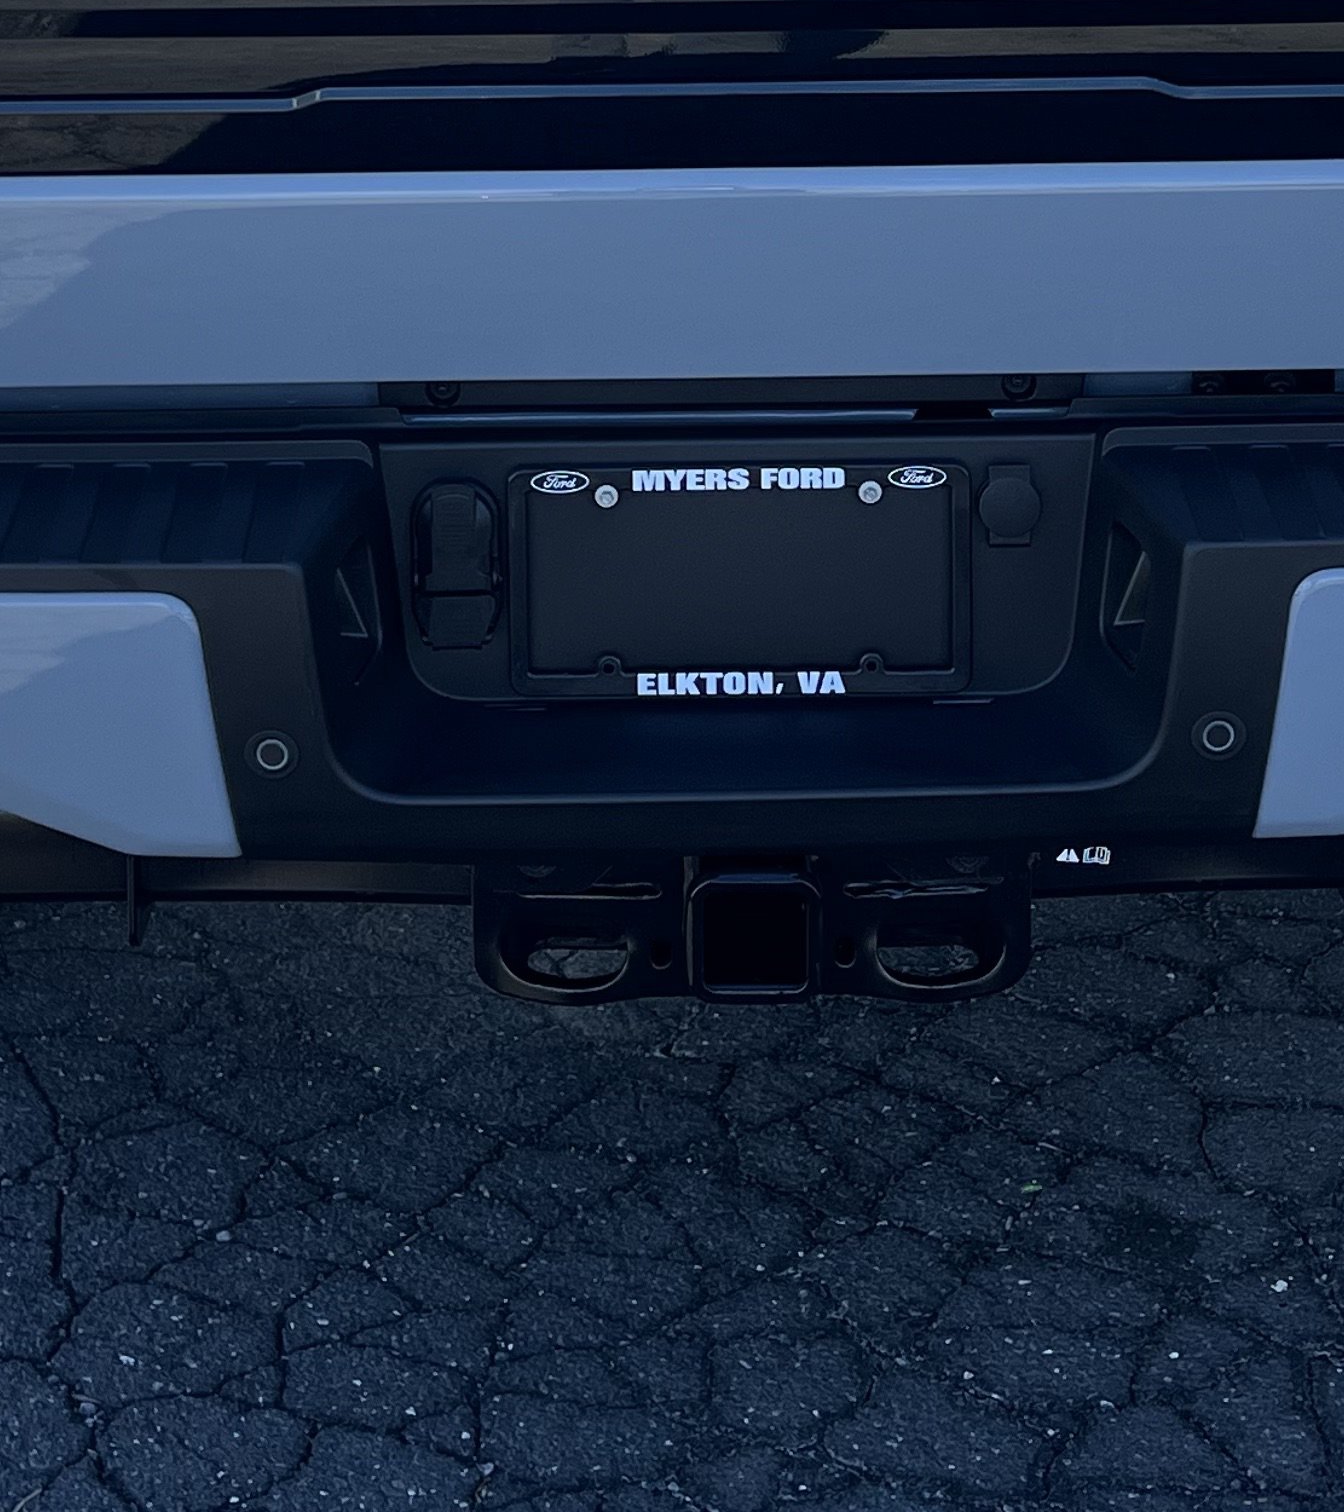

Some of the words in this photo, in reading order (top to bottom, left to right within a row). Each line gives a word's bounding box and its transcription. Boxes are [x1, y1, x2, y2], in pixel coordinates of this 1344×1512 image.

[542, 474, 578, 489] Ford
[631, 468, 751, 492] MYERS
[760, 467, 846, 490] FORD
[899, 468, 935, 484] Ford
[636, 671, 784, 696] ELKTON,
[796, 670, 846, 695] VA
